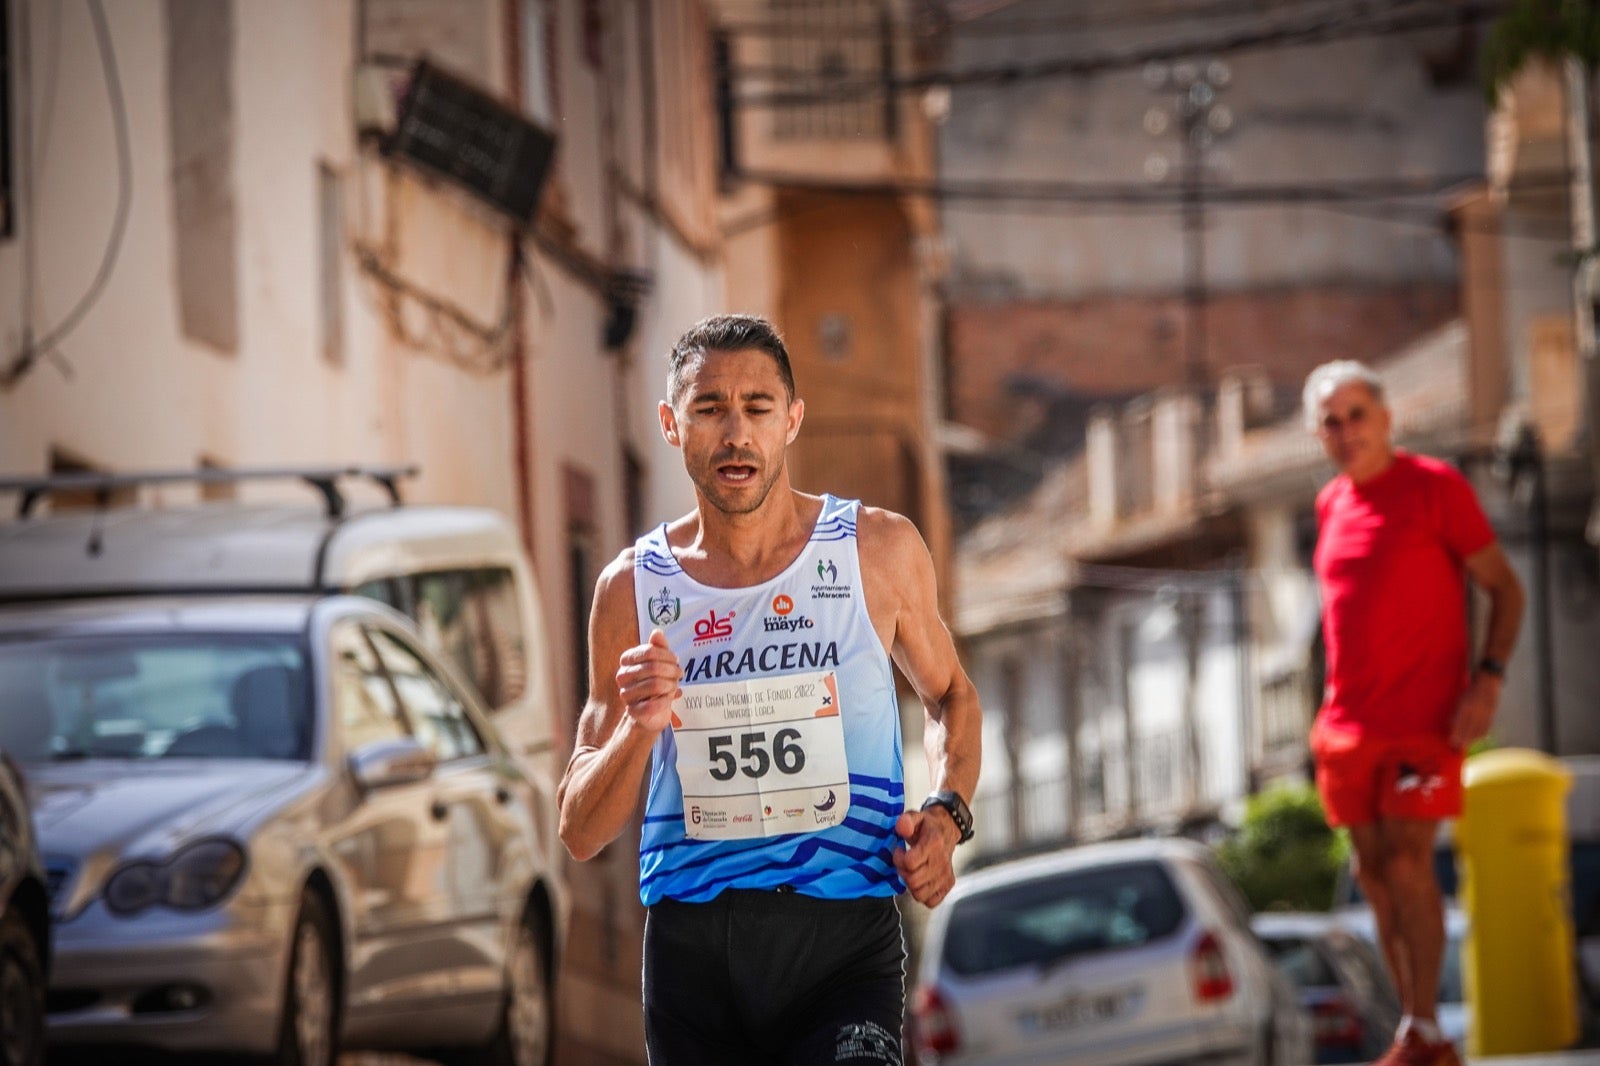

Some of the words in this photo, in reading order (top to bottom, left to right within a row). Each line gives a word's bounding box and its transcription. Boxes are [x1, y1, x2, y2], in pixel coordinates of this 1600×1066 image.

[811, 584, 851, 593] Ayuntamiento
[764, 616, 814, 632] mayfo
[794, 683, 815, 698] 2022
[708, 728, 806, 781] 556
